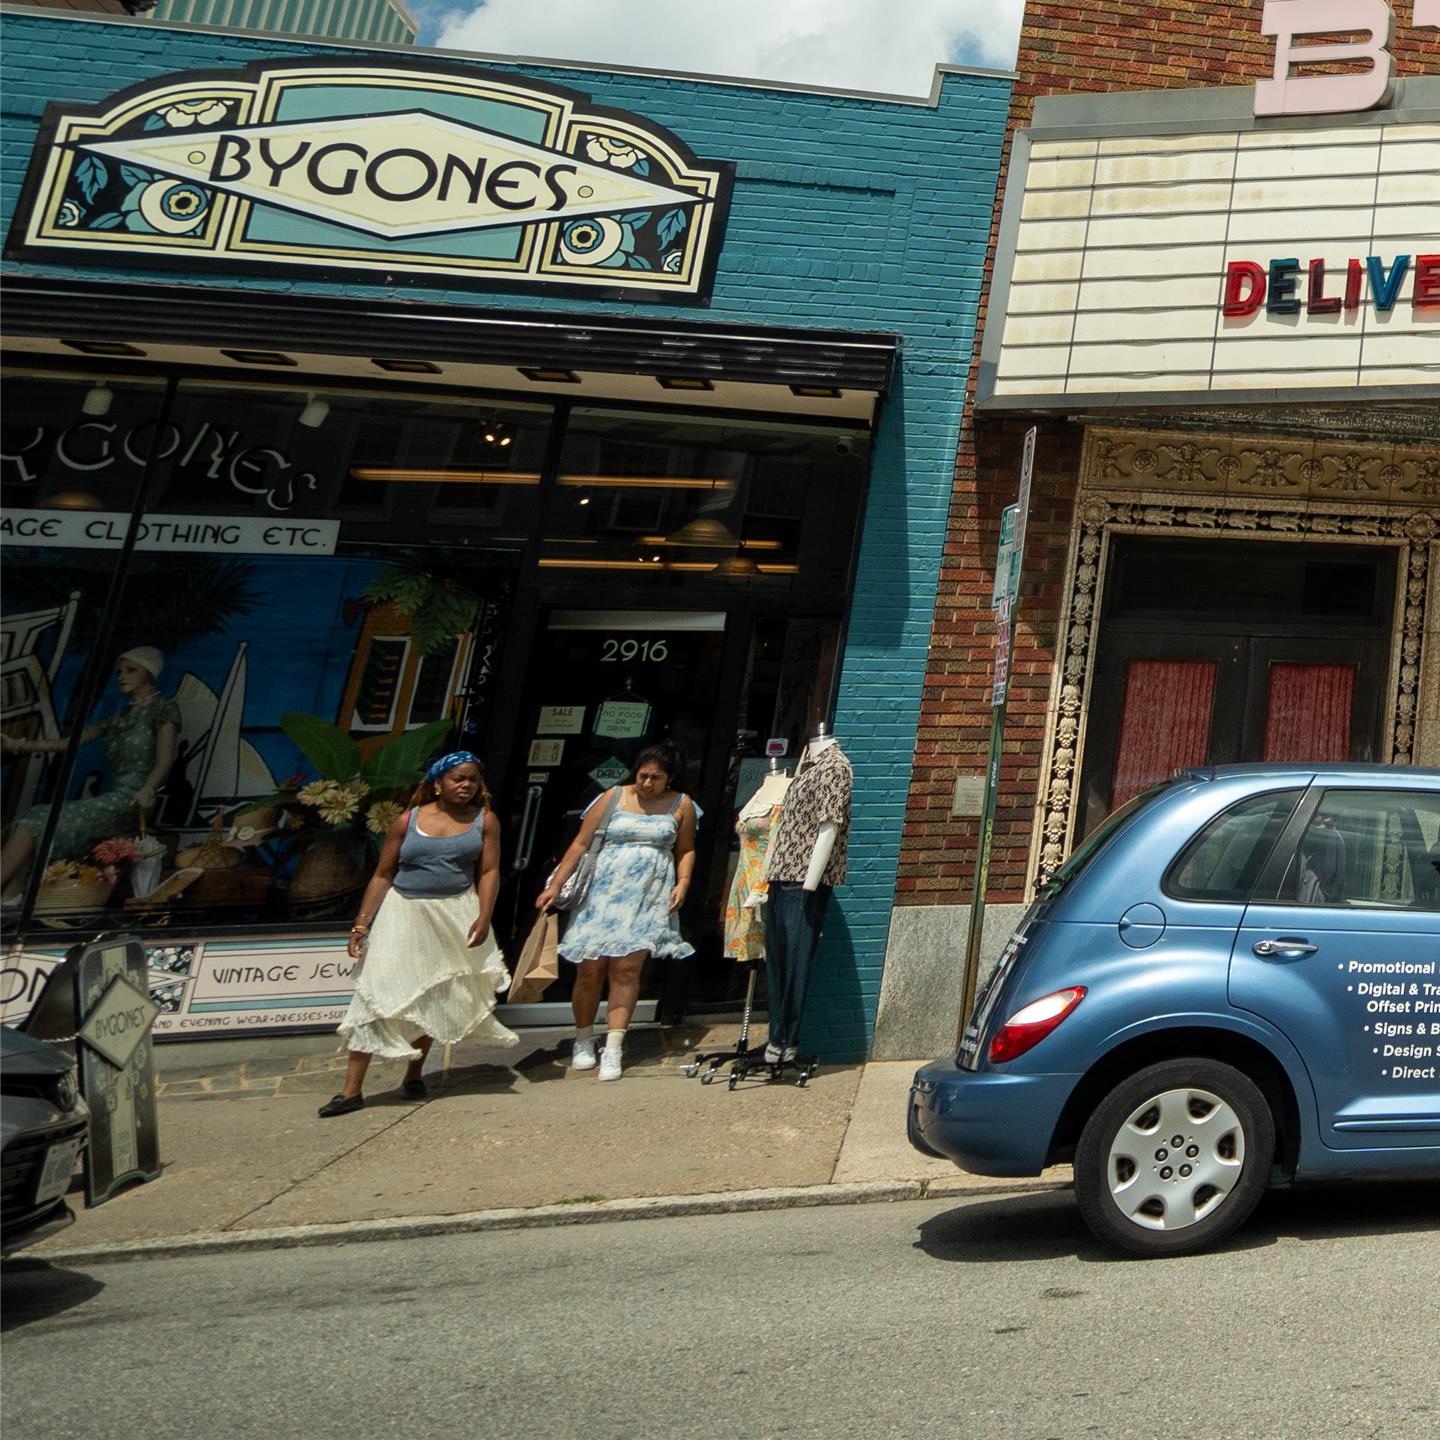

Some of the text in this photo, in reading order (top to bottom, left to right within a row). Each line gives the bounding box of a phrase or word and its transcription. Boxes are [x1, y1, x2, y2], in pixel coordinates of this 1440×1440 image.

[208, 134, 578, 212] BYGONES
[0, 516, 327, 548] AGE CLOTHING ETC.
[600, 639, 668, 662] 2916
[552, 707, 574, 717] SALE
[603, 711, 643, 719] NO FOOD
[606, 725, 632, 733] DRINK
[596, 767, 624, 778] DAILY
[1349, 961, 1435, 974] Promotional
[213, 965, 300, 985] VINTAGE
[1358, 982, 1405, 997] Digital
[1408, 983, 1419, 996] &
[1367, 1000, 1411, 1013] Offset
[96, 1005, 146, 1040] BYGONES
[180, 1016, 230, 1028] EVENING
[1374, 1022, 1413, 1037] Signs
[1416, 1022, 1426, 1035] &
[1383, 1044, 1432, 1059] Design
[1392, 1066, 1435, 1079] Direct
